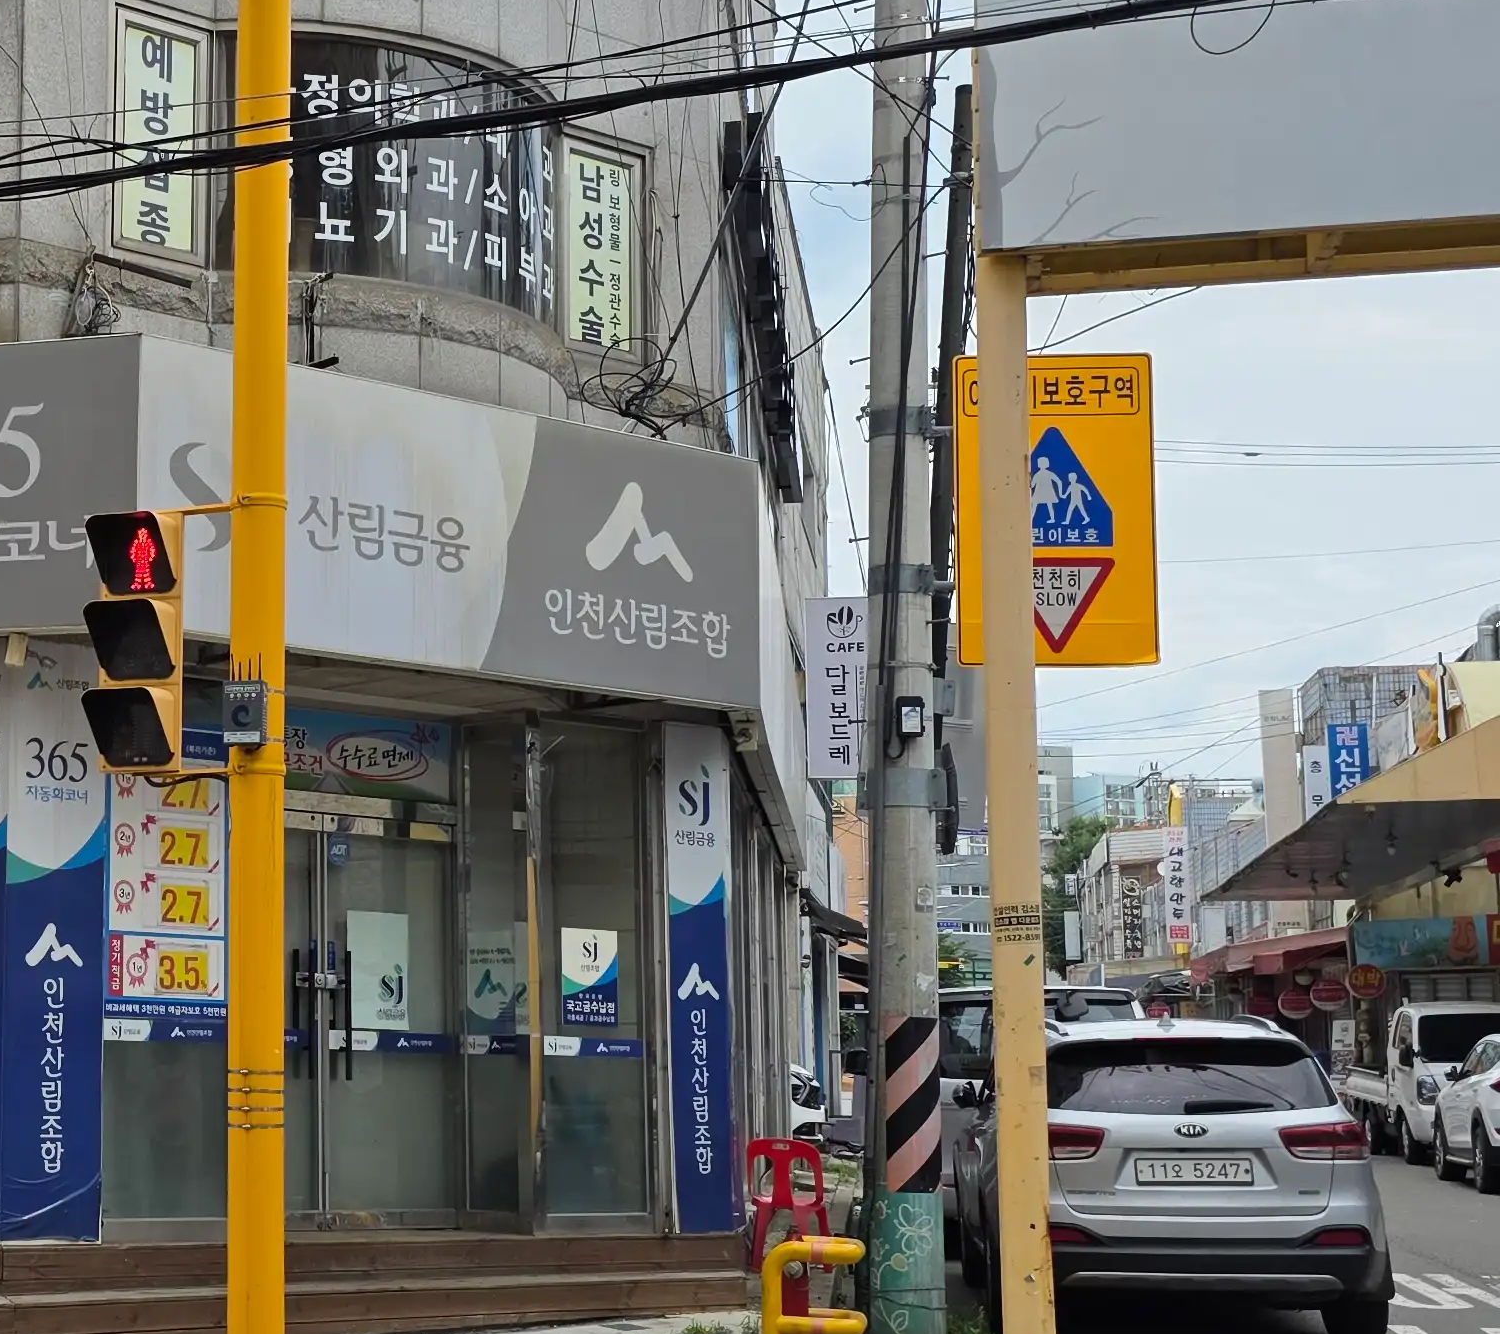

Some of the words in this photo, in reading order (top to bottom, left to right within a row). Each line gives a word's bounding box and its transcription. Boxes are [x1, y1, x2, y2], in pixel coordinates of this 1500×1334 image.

[607, 193, 622, 252] 보형물
[576, 163, 605, 347] 남성수술
[299, 494, 471, 573] 산림금융
[1031, 527, 1100, 545] 린이보호
[1032, 569, 1082, 591] 천천히
[1036, 592, 1078, 608] SLOW
[545, 588, 731, 659] 인천산림조합
[826, 642, 865, 653] CAFE
[825, 664, 851, 765] 달보드레
[24, 736, 89, 785] 365
[337, 744, 380, 769] 수수료
[381, 745, 414, 769] 면제
[25, 784, 89, 805] 자동화코너
[119, 830, 132, 843] 2년
[674, 828, 716, 849] 산림금융
[329, 844, 348, 859] ADT
[118, 888, 132, 900] 3년
[111, 938, 121, 991] 정기적금
[131, 961, 144, 974] 1년
[1352, 969, 1381, 987] 대박
[566, 1000, 615, 1014] 국고금수납점
[39, 976, 66, 1175] 인천산림조합
[689, 1007, 713, 1176] 인천산림조합
[1180, 1124, 1202, 1136] KIA
[1150, 1164, 1183, 1179] 11오
[1193, 1163, 1240, 1179] 5247
